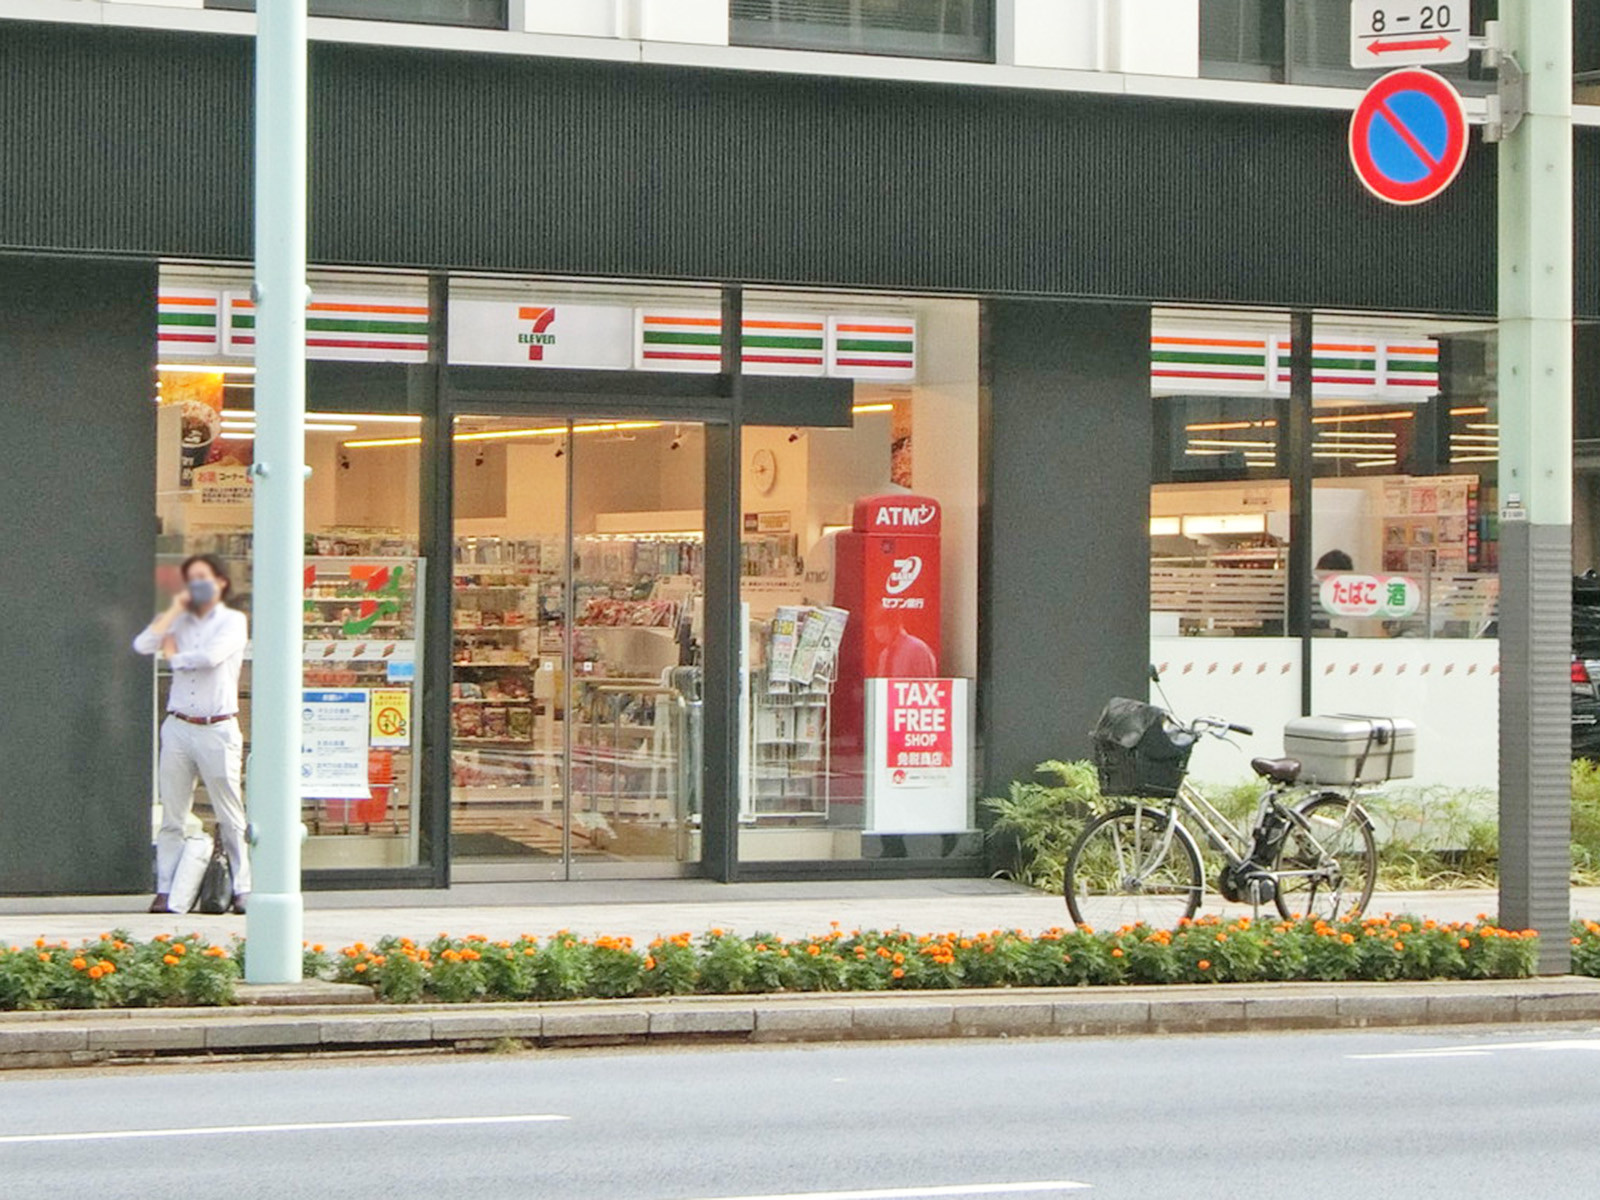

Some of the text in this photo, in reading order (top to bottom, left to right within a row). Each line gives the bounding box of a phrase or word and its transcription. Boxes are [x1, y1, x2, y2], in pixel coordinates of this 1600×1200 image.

[1333, 581, 1406, 606] たばこ 酒
[894, 708, 946, 732] FREE
[904, 733, 938, 747] SHOP
